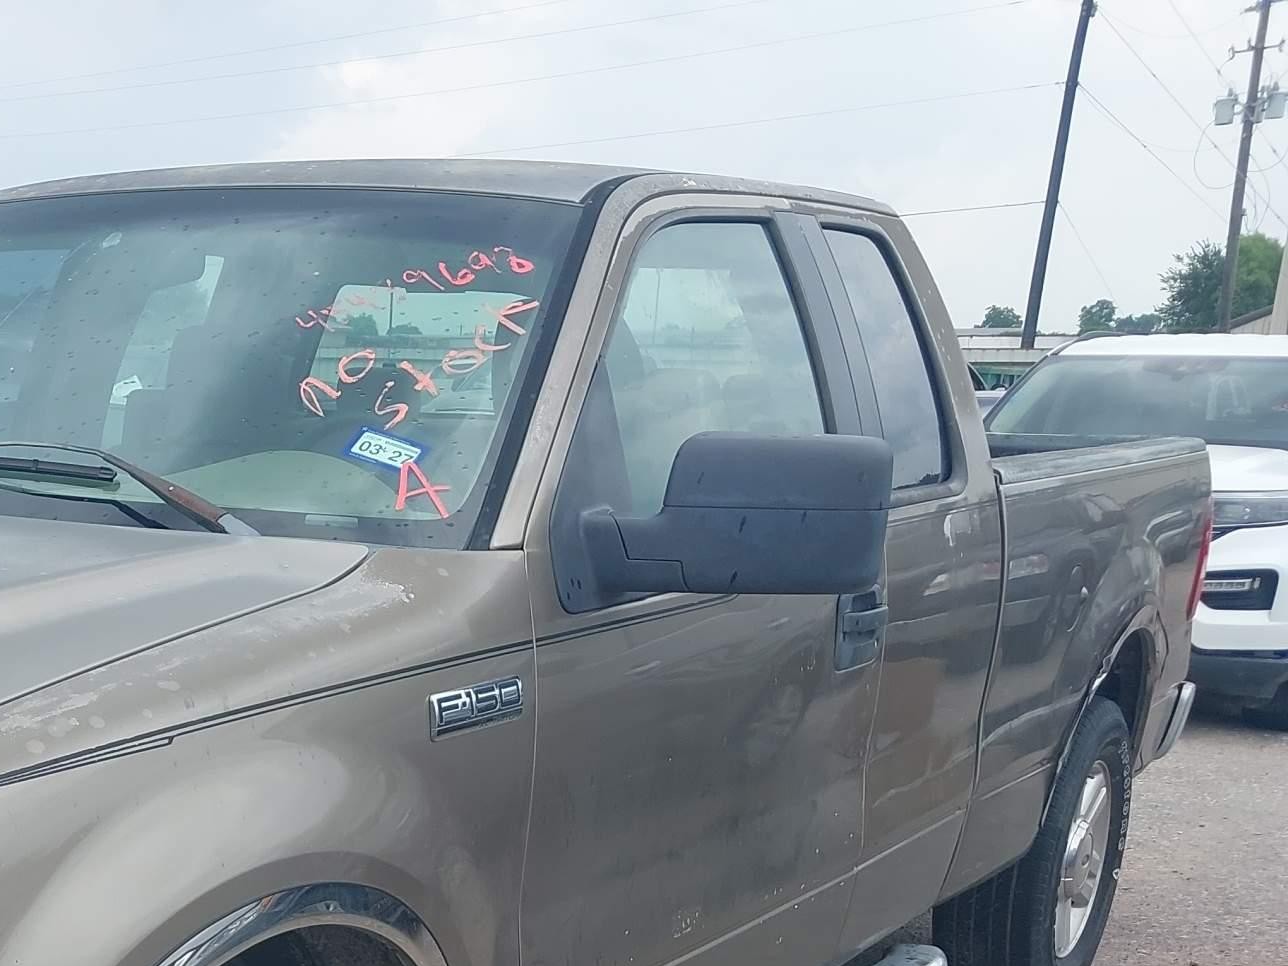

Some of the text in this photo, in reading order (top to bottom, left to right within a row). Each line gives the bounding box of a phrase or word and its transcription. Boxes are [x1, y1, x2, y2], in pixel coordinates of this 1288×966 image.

[358, 440, 383, 455] 03
[387, 450, 414, 465] 27
[394, 460, 452, 519] A
